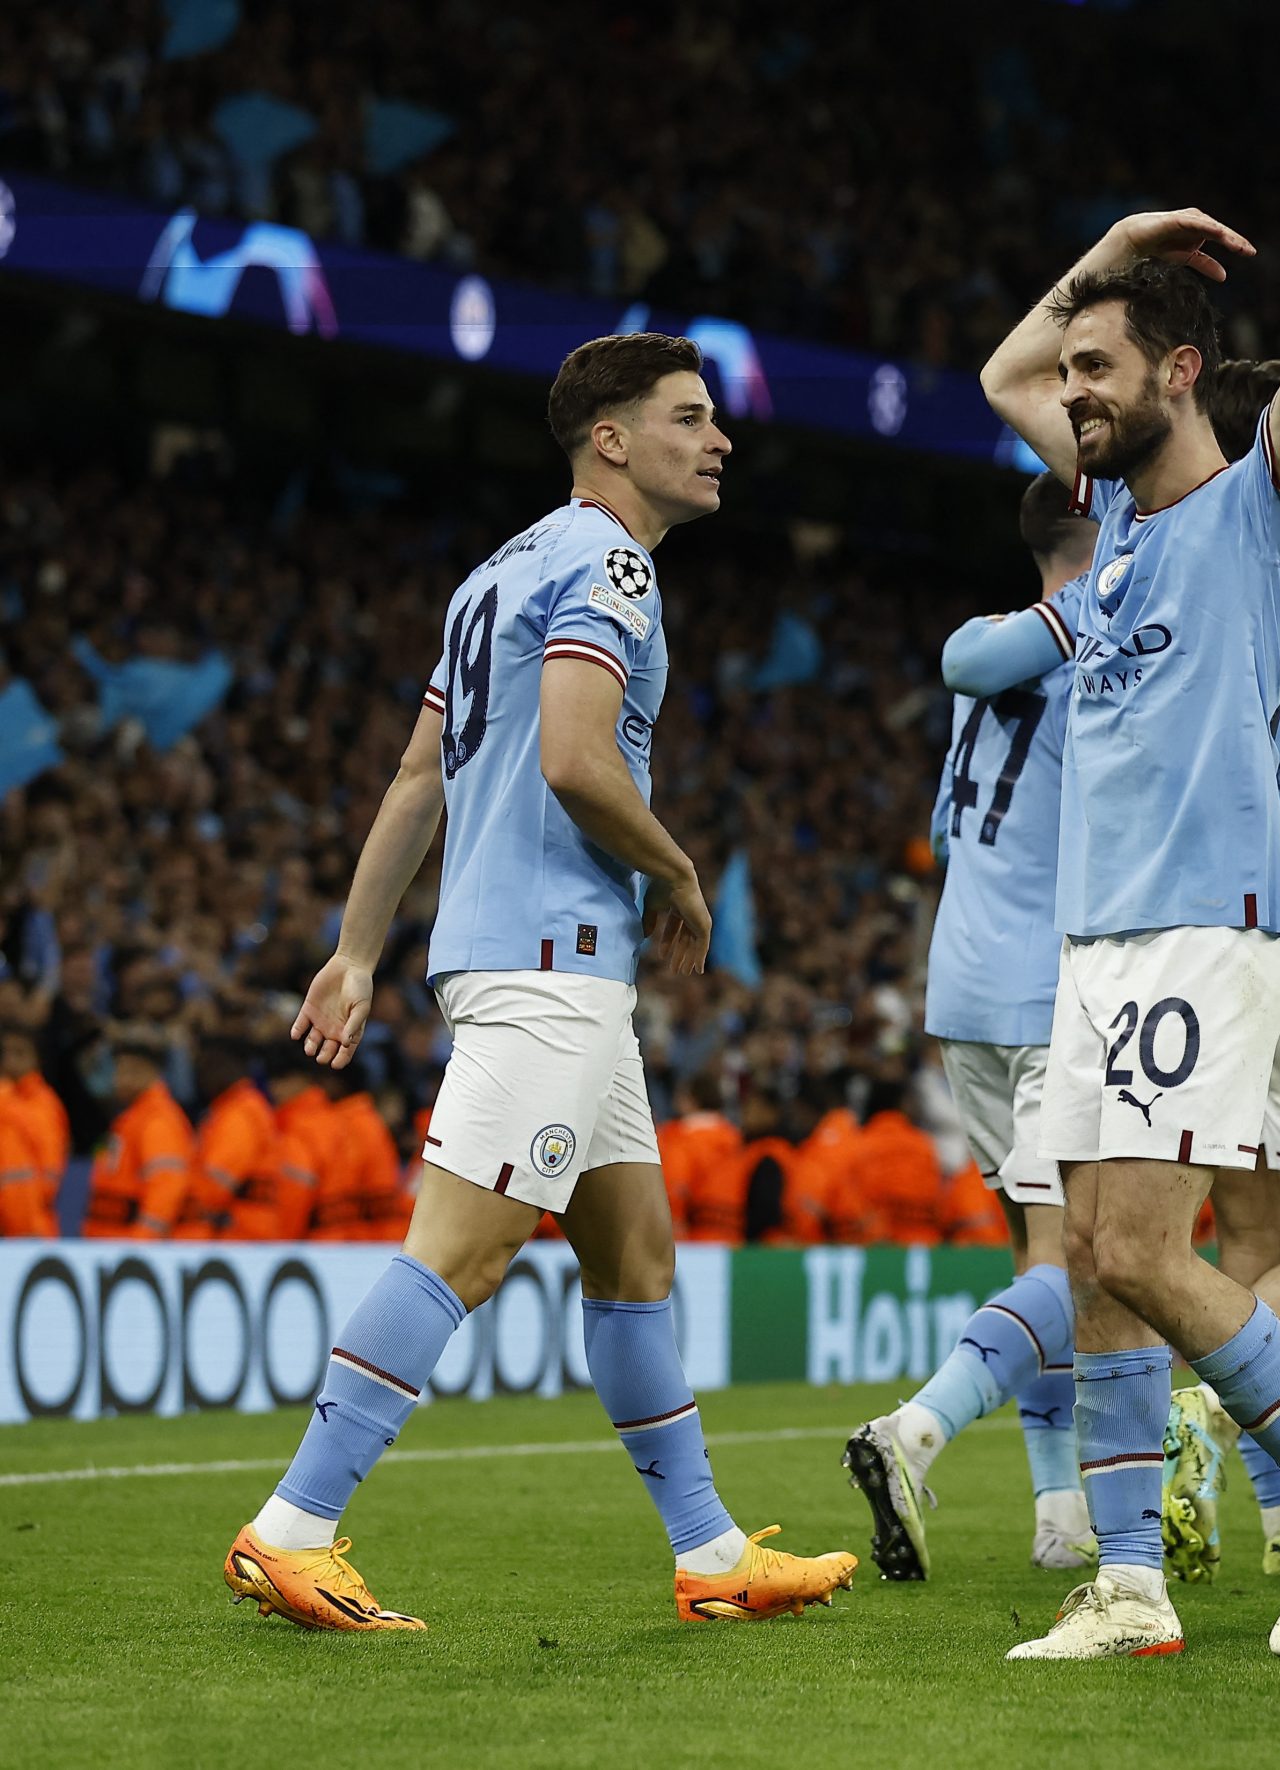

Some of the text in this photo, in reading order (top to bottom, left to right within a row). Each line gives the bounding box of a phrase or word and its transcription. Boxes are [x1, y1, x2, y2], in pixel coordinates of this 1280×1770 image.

[591, 590, 647, 632] FOUNDATION
[441, 583, 498, 780] 19
[1079, 668, 1143, 694] WAYS
[952, 689, 1048, 846] 47
[1103, 997, 1200, 1088] 20
[540, 1128, 573, 1149] MANCHESTER
[541, 1166, 556, 1175] CITY
[15, 1256, 328, 1416] oppo
